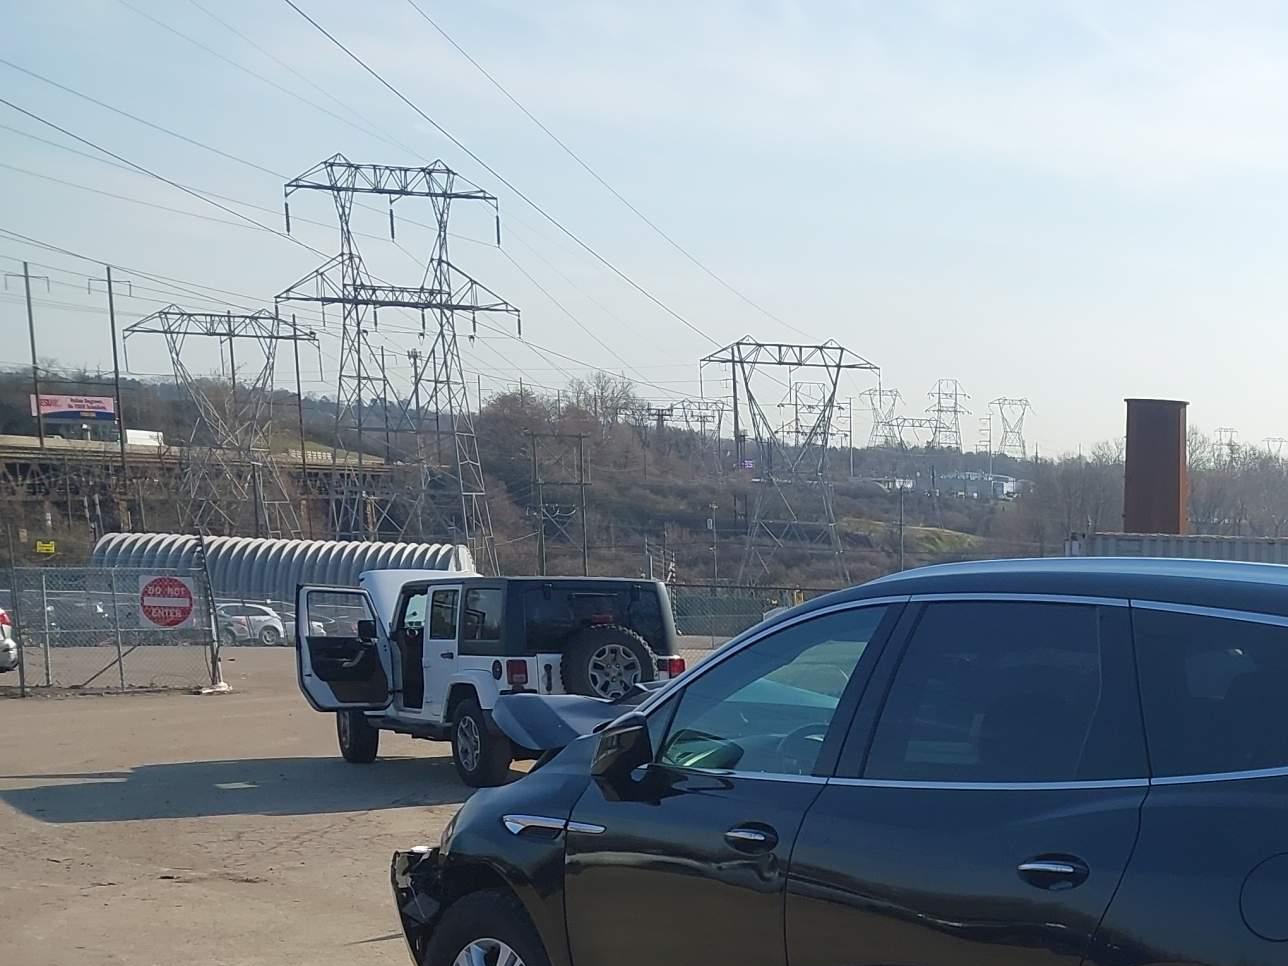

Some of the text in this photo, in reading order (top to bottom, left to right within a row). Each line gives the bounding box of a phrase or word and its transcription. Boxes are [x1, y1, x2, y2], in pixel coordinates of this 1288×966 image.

[147, 586, 185, 595] DO NOT
[151, 608, 181, 617] ENTER
